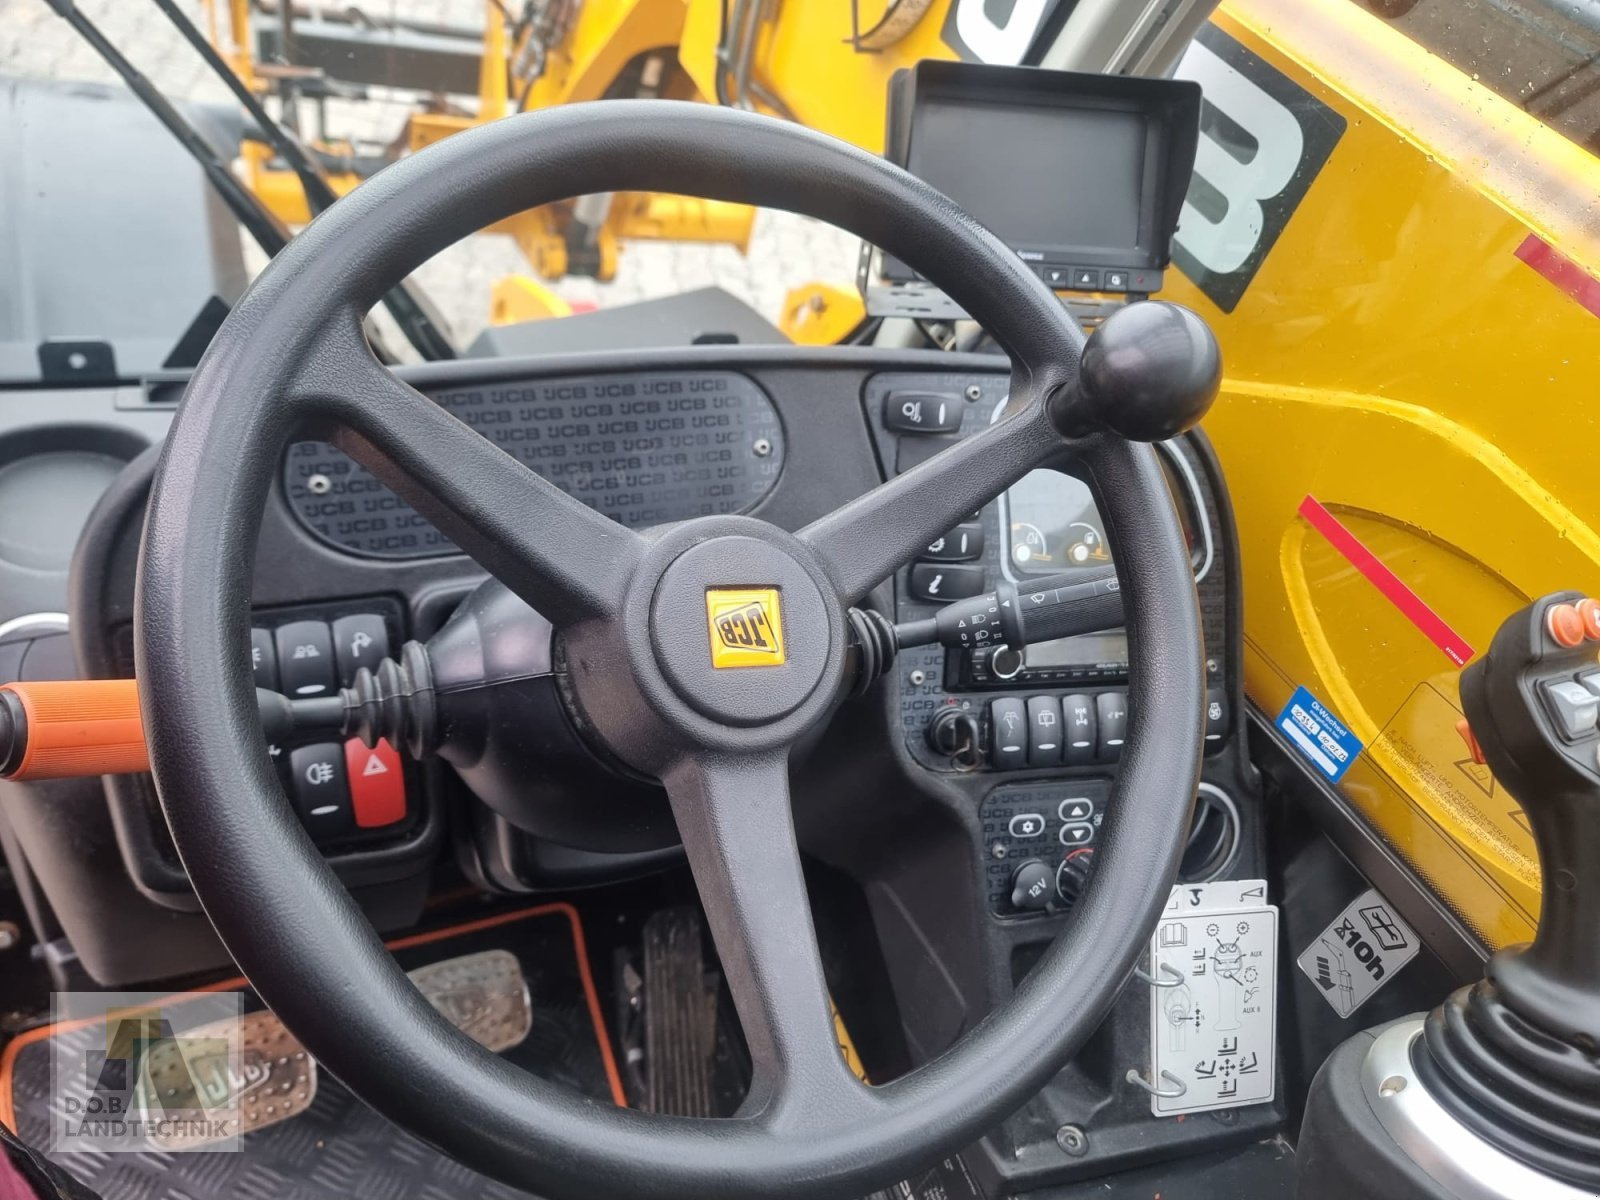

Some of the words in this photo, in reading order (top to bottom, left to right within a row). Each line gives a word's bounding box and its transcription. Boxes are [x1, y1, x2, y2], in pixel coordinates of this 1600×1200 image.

[492, 389, 536, 403] JCB
[543, 386, 587, 401] JCB
[594, 383, 636, 398] JCB
[643, 381, 683, 395] JCB
[689, 379, 727, 392] JCB
[466, 410, 512, 425] JCB
[520, 407, 564, 421] JCB
[571, 403, 613, 418] JCB
[620, 400, 661, 415] JCB
[667, 398, 707, 412] JCB
[496, 427, 540, 442] JCB
[547, 424, 591, 439] JCB
[597, 421, 639, 435] JCB
[645, 417, 685, 431] JCB
[692, 415, 730, 428] JCB
[524, 444, 567, 459] JCB
[574, 440, 617, 456] JCB
[623, 437, 663, 451] JCB
[299, 462, 350, 477] JCB
[551, 461, 594, 476] JCB
[601, 457, 642, 471] JCB
[648, 453, 688, 467] JCB
[333, 479, 382, 496] JCB
[626, 473, 666, 487] JCB
[304, 501, 355, 518] JCB
[604, 493, 645, 508] JCB
[337, 518, 387, 535] JCB
[369, 534, 417, 550] JCB
[719, 607, 768, 648] JCB
[903, 700, 935, 711] JCB
[1311, 700, 1348, 737] Öl-Wechsel
[983, 808, 1013, 819] JCB
[1028, 877, 1048, 899] 12V
[1346, 930, 1385, 981] 10h
